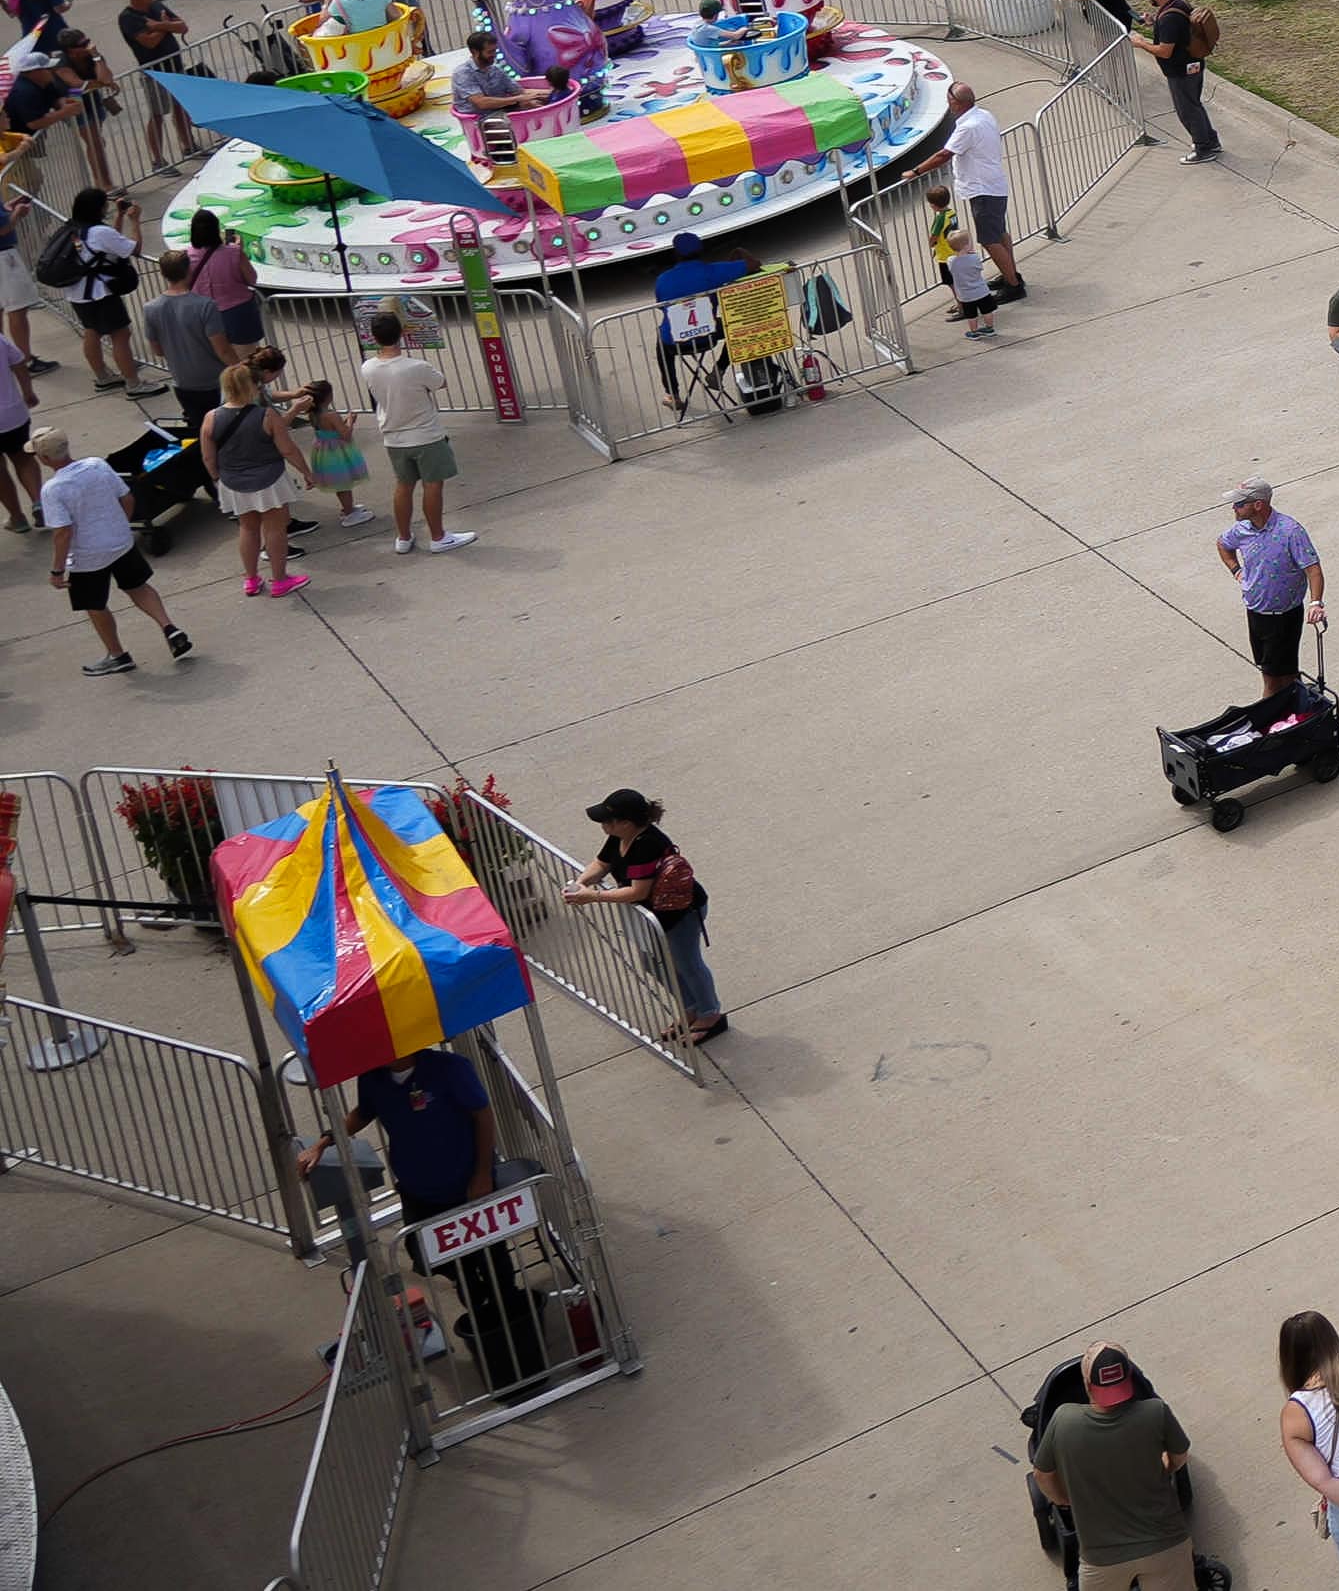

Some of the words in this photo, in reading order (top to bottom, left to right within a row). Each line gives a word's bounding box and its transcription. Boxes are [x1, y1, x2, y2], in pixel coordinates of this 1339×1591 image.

[679, 325, 711, 339] CREDITS
[687, 309, 699, 327] 4
[488, 341, 509, 396] SORRY
[433, 1195, 523, 1254] EXIT
